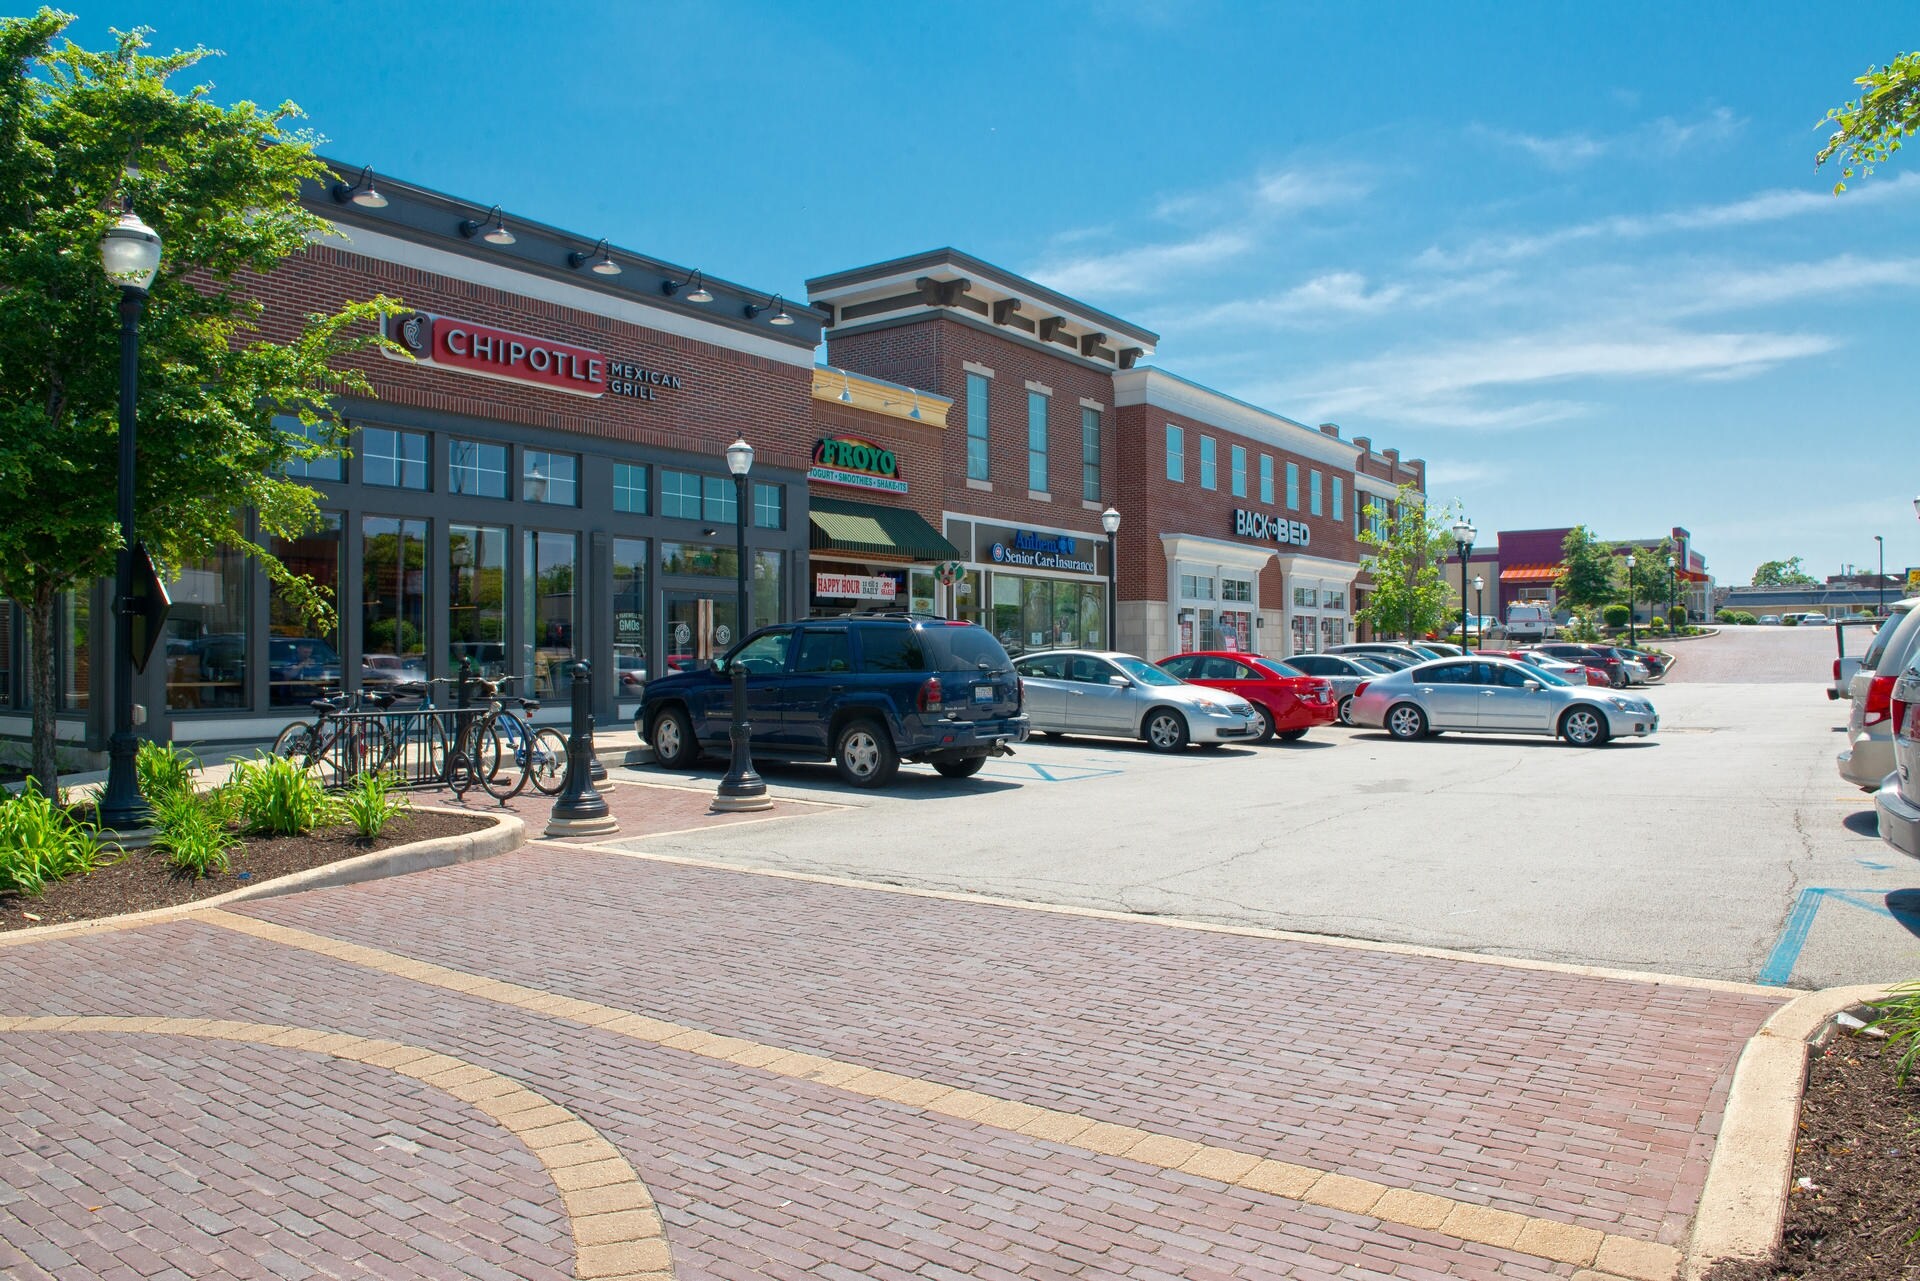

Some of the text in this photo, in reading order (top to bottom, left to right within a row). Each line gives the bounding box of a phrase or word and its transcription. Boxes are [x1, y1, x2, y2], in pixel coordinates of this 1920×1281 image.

[447, 329, 603, 383] CHIPOTLE
[611, 362, 682, 390] MEXICAN
[611, 380, 656, 401] GRILL
[822, 439, 896, 475] FROYO
[838, 473, 873, 487] SMOOTHIES
[1235, 508, 1270, 540] BACK
[1277, 517, 1311, 547] BED
[1005, 548, 1094, 571] Senior Care Insurance
[817, 577, 841, 593] HAPPY
[842, 579, 860, 594] HOUR
[862, 587, 879, 595] DAILY
[619, 619, 640, 632] GMOs
